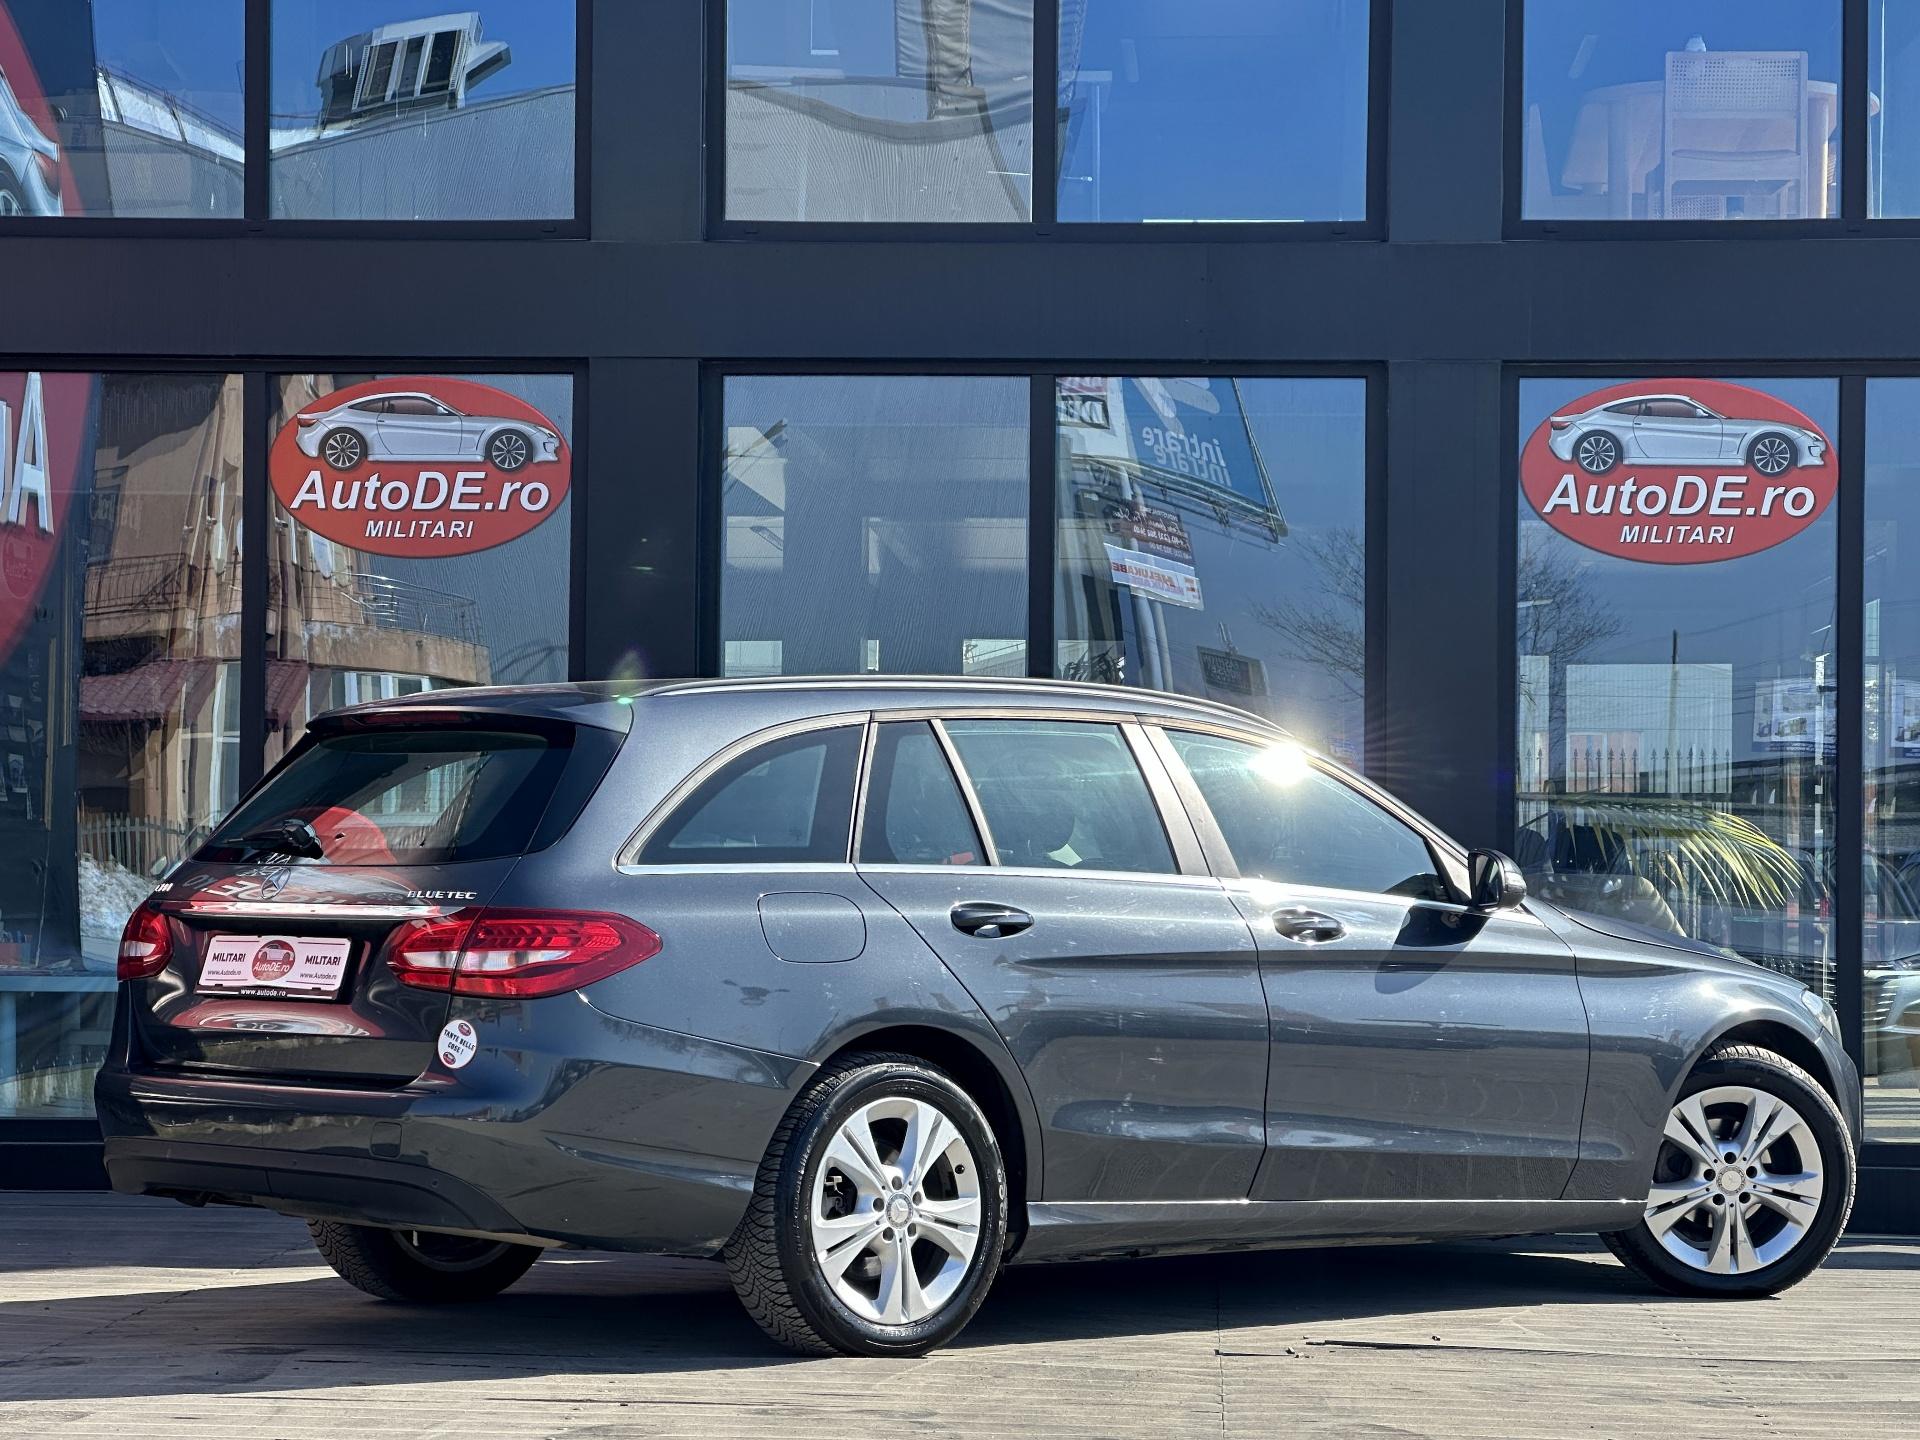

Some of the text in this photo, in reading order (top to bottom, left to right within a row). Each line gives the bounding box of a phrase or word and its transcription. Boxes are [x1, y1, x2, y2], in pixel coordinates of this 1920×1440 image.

[290, 470, 550, 512] AutoDE.ro
[1543, 473, 1815, 517] AutoDE.ro
[365, 520, 474, 538] MILITARI
[1620, 525, 1734, 544] MILITARI
[407, 890, 477, 900] BLUETEC
[212, 953, 341, 966] MILITARI MILITARI
[253, 961, 290, 973] AutoDE.ro
[240, 989, 286, 997] www.autode.ro
